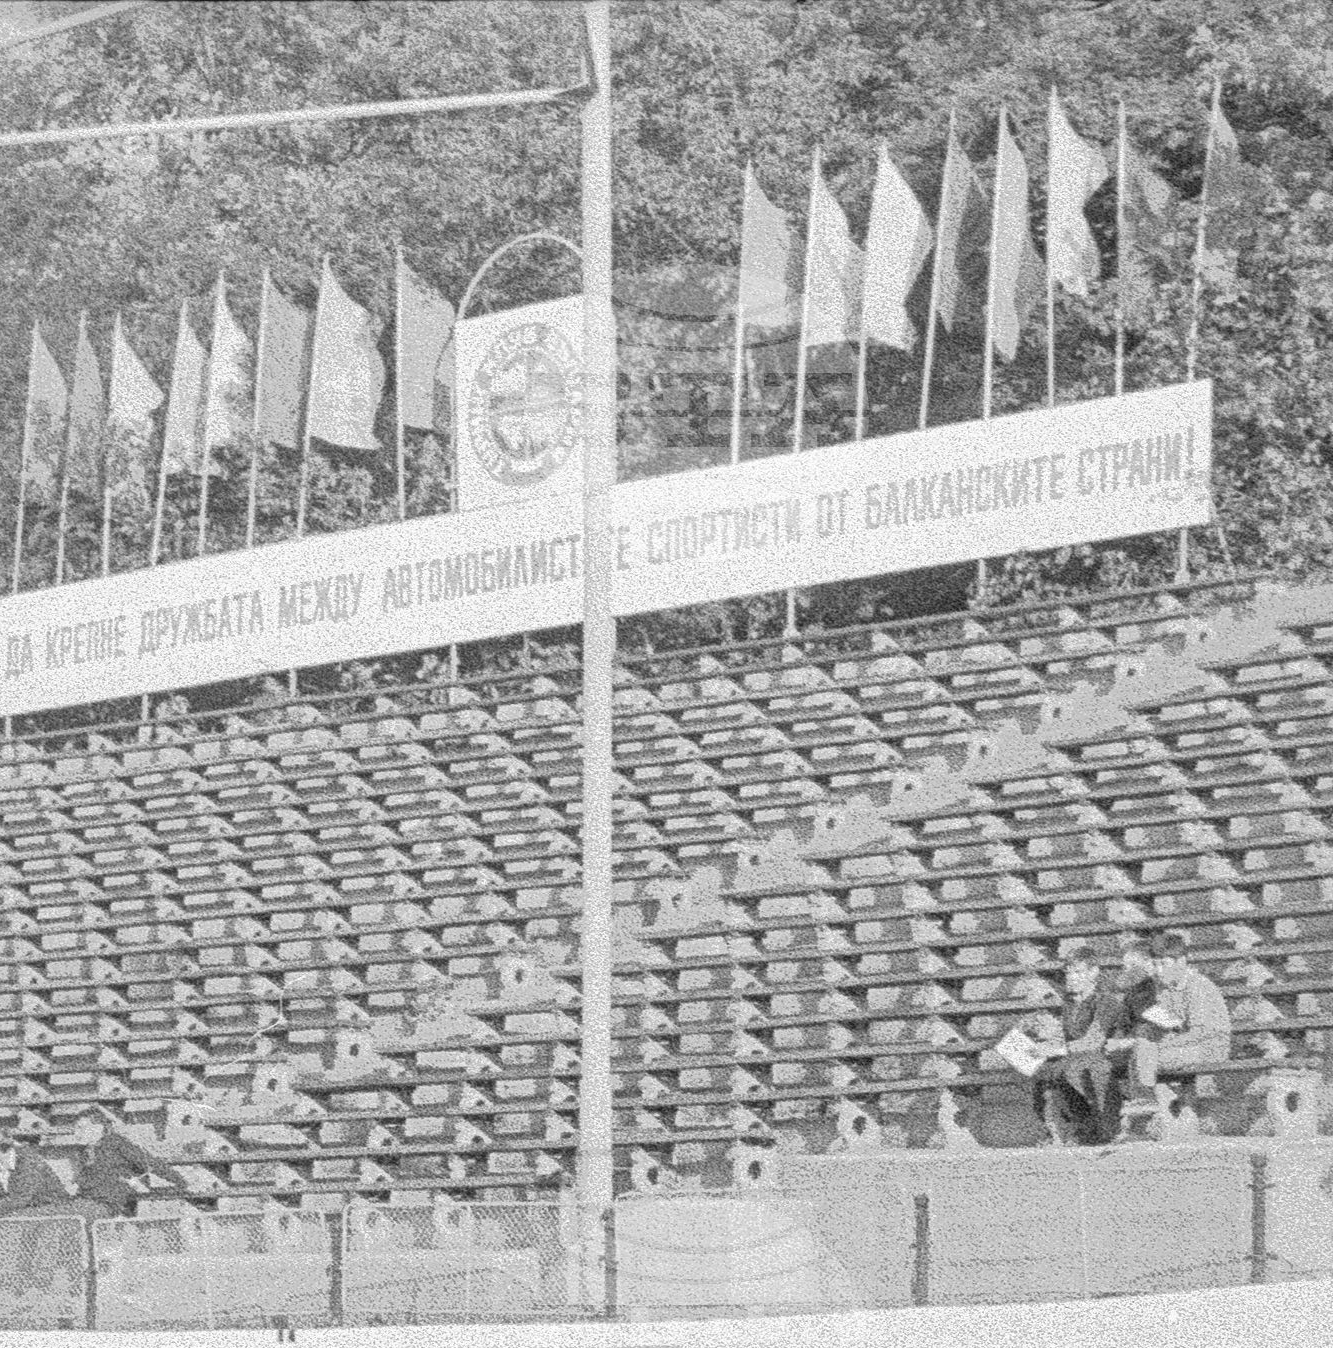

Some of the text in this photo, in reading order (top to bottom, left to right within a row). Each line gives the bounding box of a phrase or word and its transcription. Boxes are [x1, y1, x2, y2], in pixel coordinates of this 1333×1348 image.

[4, 632, 33, 680] ДА
[45, 614, 126, 663] КРЕПНЕ
[139, 589, 265, 657] ДРУЖБАТА
[277, 573, 364, 629] МЕЖДУ
[382, 523, 630, 614] АВТОМОБИЛИСТЕ
[647, 499, 802, 565] СПОРТИСТИ
[815, 487, 850, 538] ОТ
[864, 451, 1067, 532] БАЛКАНСКИТЕ
